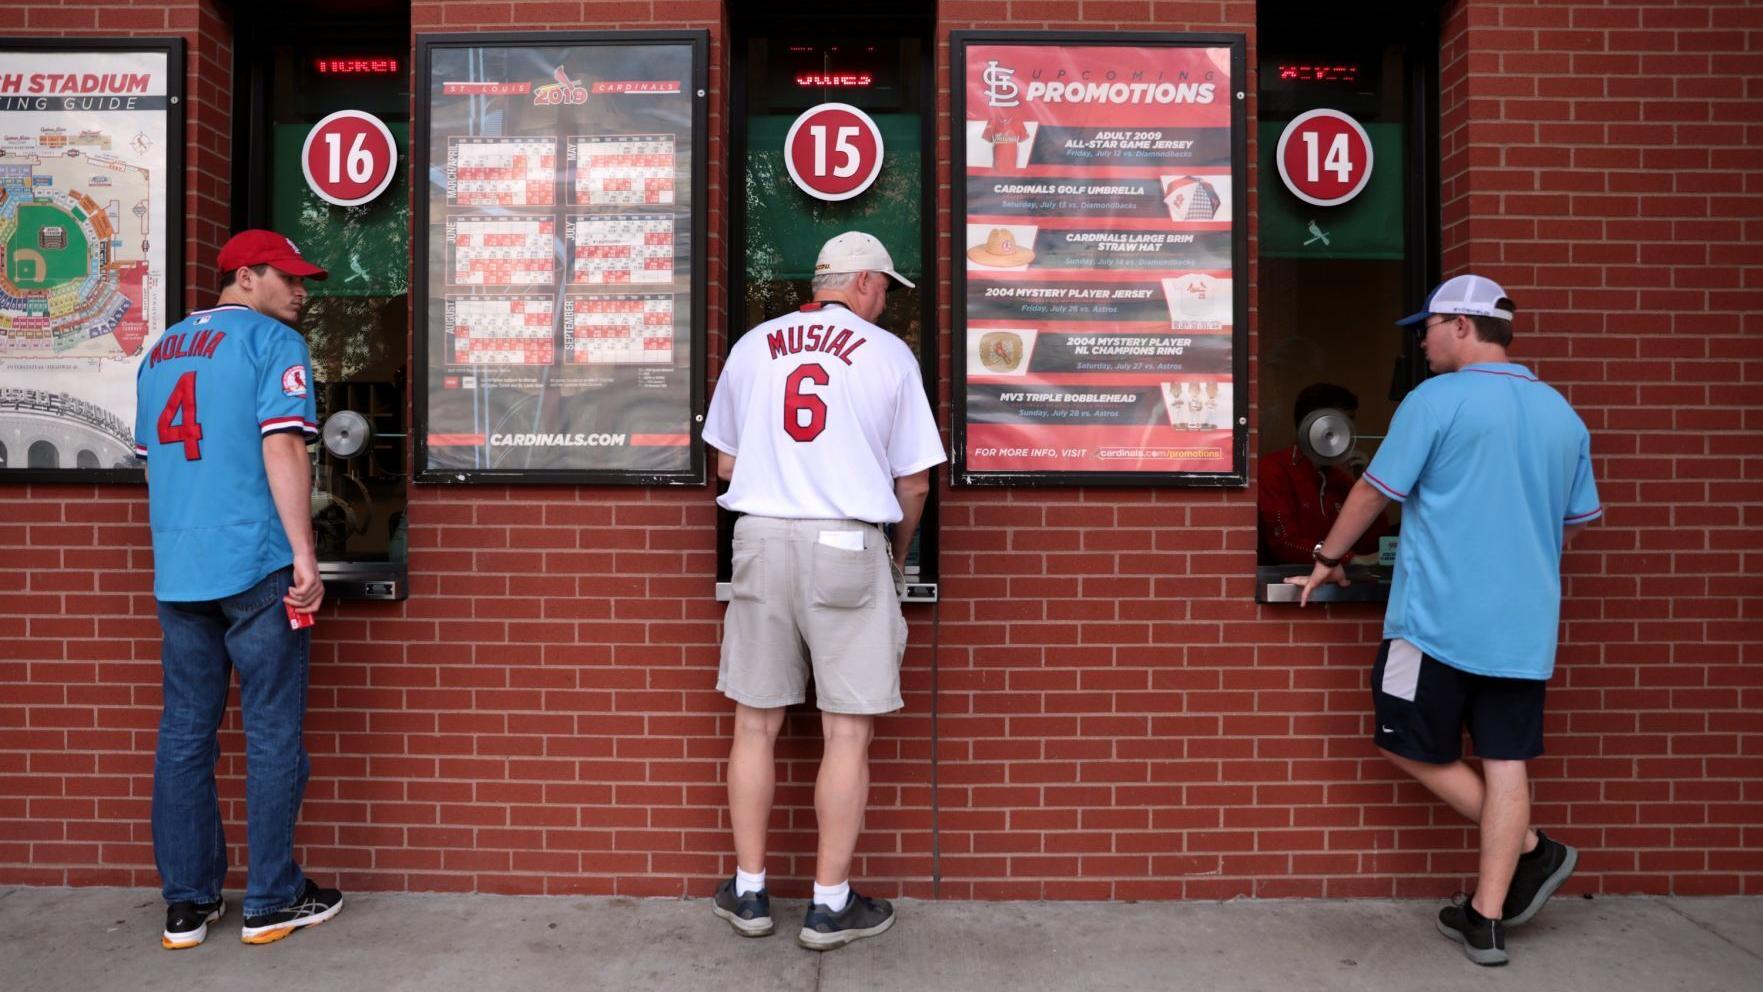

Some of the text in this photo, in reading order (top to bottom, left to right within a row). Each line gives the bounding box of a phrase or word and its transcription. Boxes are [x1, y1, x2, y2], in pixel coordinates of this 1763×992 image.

[1031, 68, 1215, 81] UPCOMING
[0, 74, 151, 93] H STADIUM
[481, 85, 526, 93] LOUIS
[599, 83, 675, 92] CARDINALS
[533, 86, 588, 106] 2019
[1025, 82, 1216, 104] PROMOTIONS
[0, 97, 137, 110] ING GUIDE
[1095, 132, 1162, 140] ADULT 2009
[1064, 140, 1194, 149] ALL-STAR GAME JERSEY
[325, 132, 374, 184] 16
[567, 143, 577, 161] MAY
[810, 125, 861, 178] 15
[1066, 150, 1093, 158] Friday,
[1135, 150, 1192, 158] Diamondbacks
[1303, 131, 1353, 183] 14
[447, 144, 459, 198] MARCH/APRIL
[994, 184, 1145, 195] CARDINALS GOLF UMBRELLA
[1002, 200, 1038, 209] Saturday,
[1040, 200, 1056, 209] July
[1080, 201, 1137, 209] Diamondbacks
[447, 221, 457, 243] JUNE
[565, 222, 576, 241] JULY
[1066, 233, 1194, 243] CARDINALS LARGE BRIM
[1097, 242, 1162, 251] STRAW HAT
[985, 288, 1153, 298] 2004 MYSTERY PLAYER JERSEY
[1021, 304, 1049, 313] Friday,
[1050, 305, 1066, 313] July
[1092, 305, 1118, 313] Astros
[445, 300, 456, 334] AUGUST
[564, 299, 575, 351] SEPTEMBER
[767, 324, 867, 366] MUSIAL
[1066, 337, 1192, 346] 2004 MYSTERY PLAYER
[150, 329, 226, 369] MOLINA
[1075, 346, 1183, 355] NL CHAMPIONS RING
[1076, 362, 1113, 370] Saturday,
[1115, 363, 1131, 371] July
[783, 363, 830, 442] 6
[1000, 393, 1137, 402] MV3 TRIPLE BOBBLEHEAD
[157, 370, 203, 462] 4
[1018, 409, 1050, 417] Sunday,
[1052, 409, 1068, 417] July
[490, 433, 626, 446] CARDINALS.COM
[975, 448, 1087, 458] FOR MORE INFO, VISIT
[1100, 449, 1220, 459] cardinals.com/promotions
